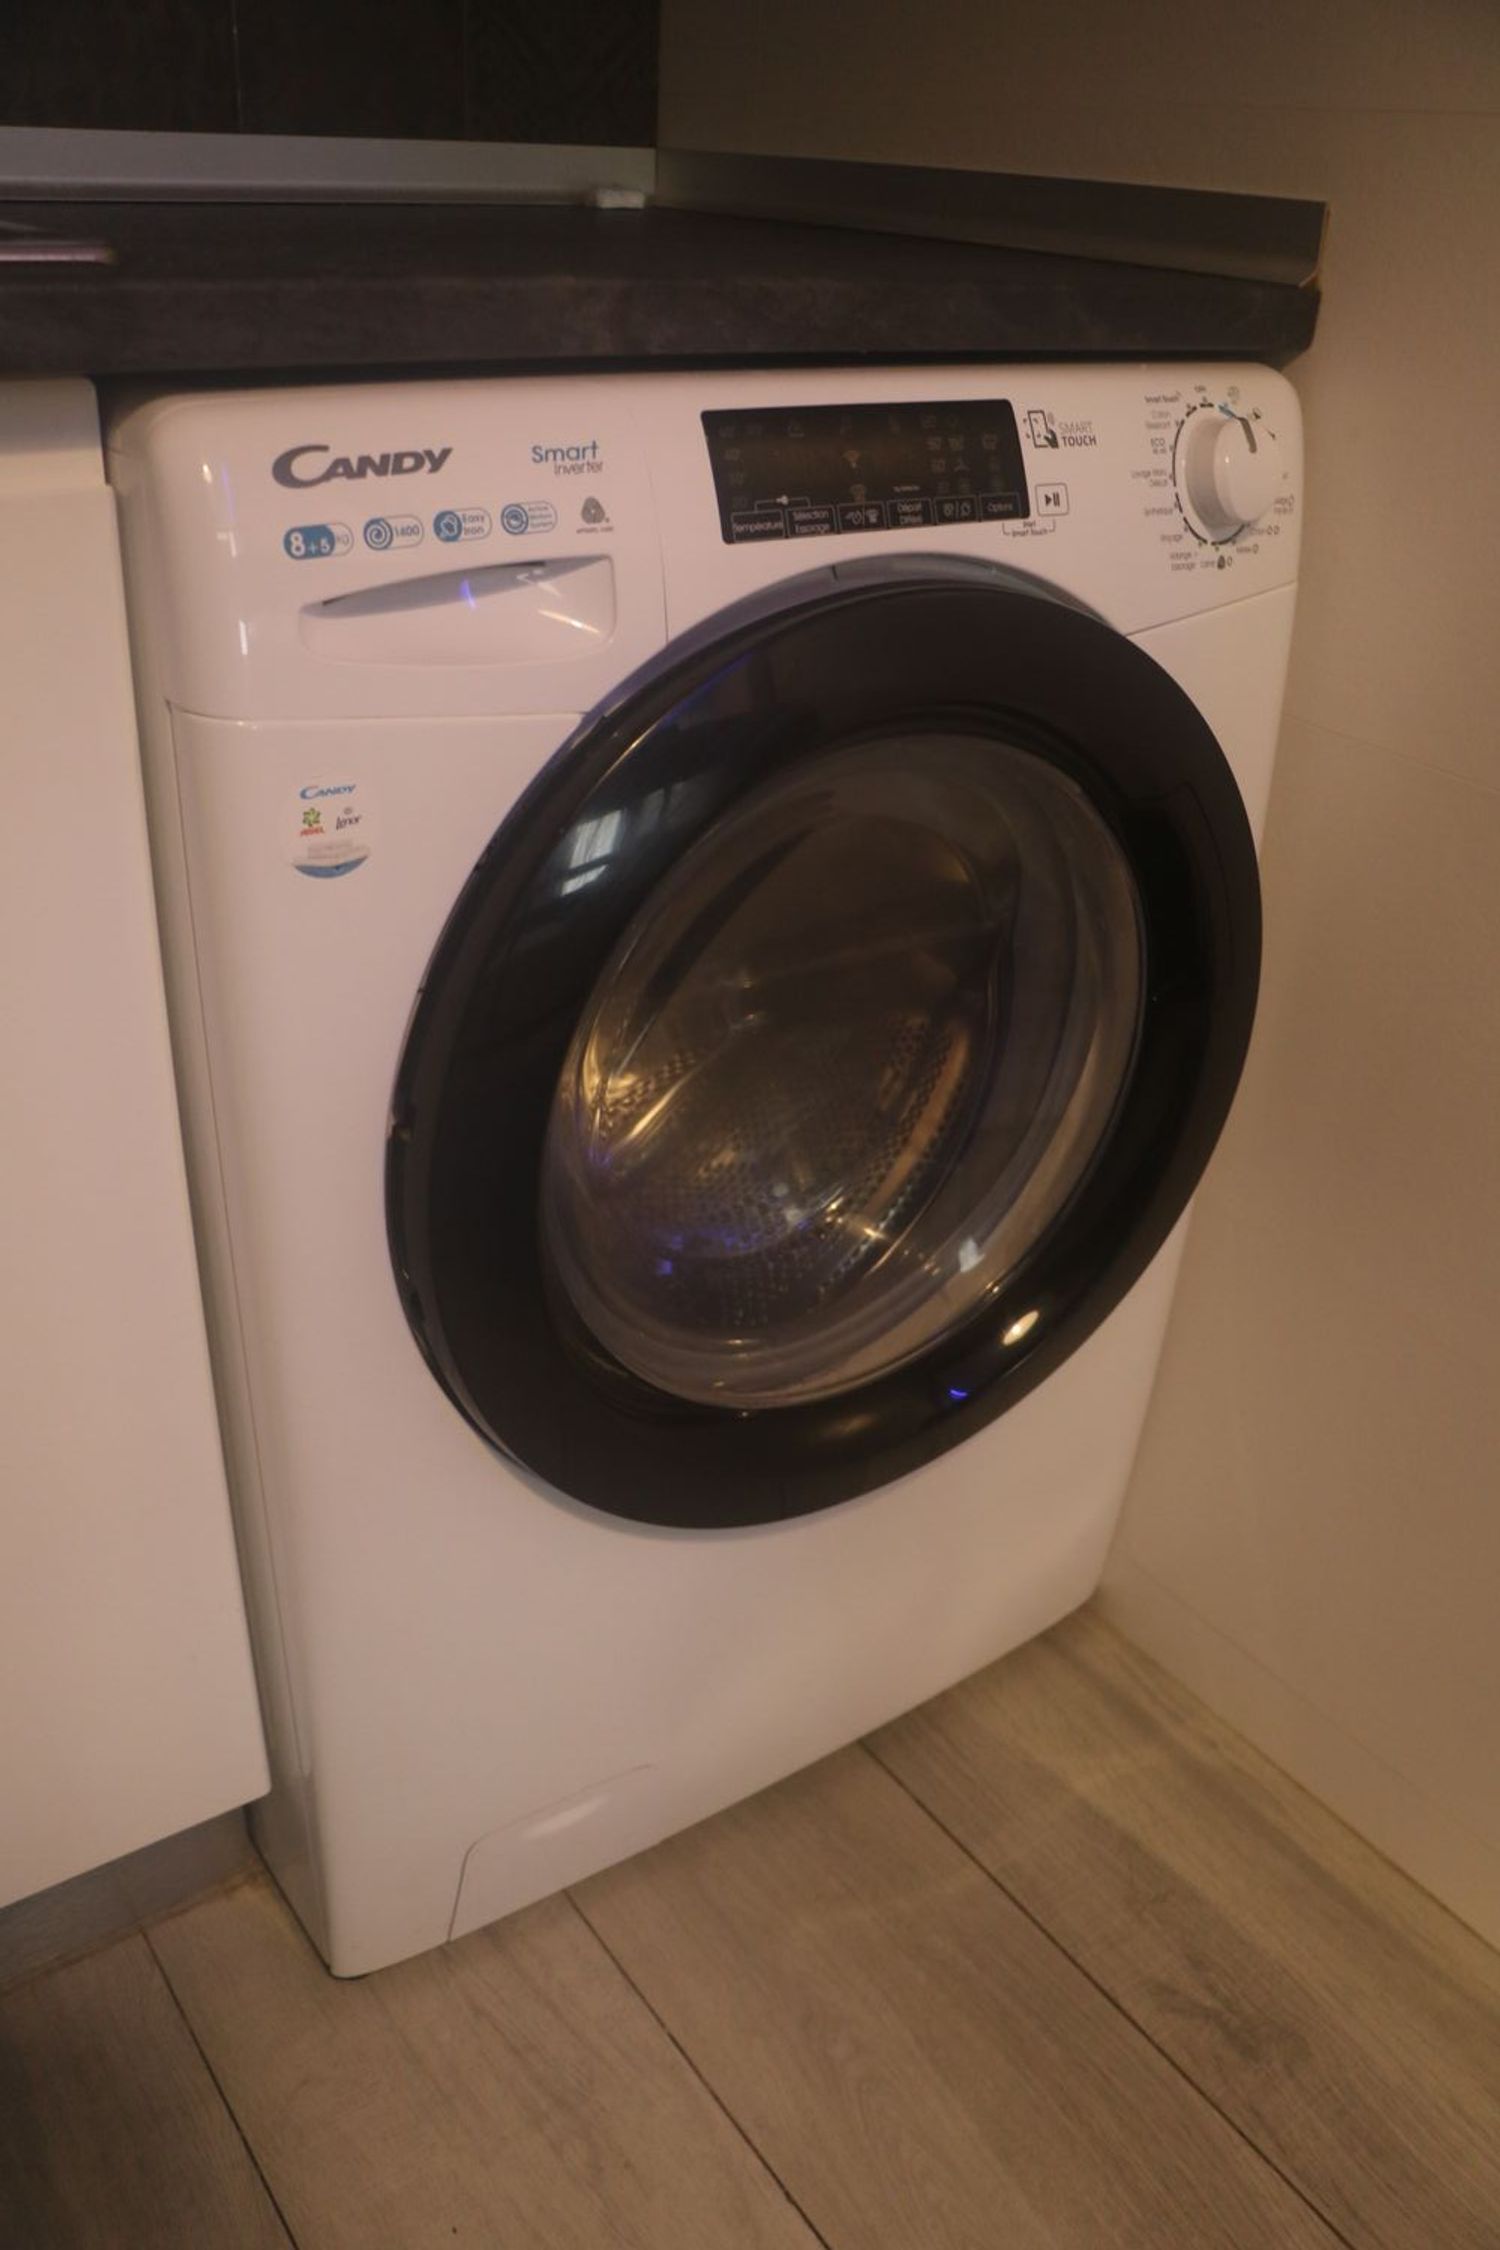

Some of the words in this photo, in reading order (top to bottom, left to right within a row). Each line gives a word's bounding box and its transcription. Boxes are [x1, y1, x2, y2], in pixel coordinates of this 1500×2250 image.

[1058, 420, 1094, 434] SMART
[1061, 435, 1097, 447] TOUCH
[532, 440, 600, 464] Smart
[272, 444, 453, 489] CANDY
[555, 458, 604, 477] Inverter
[395, 525, 420, 538] 1400
